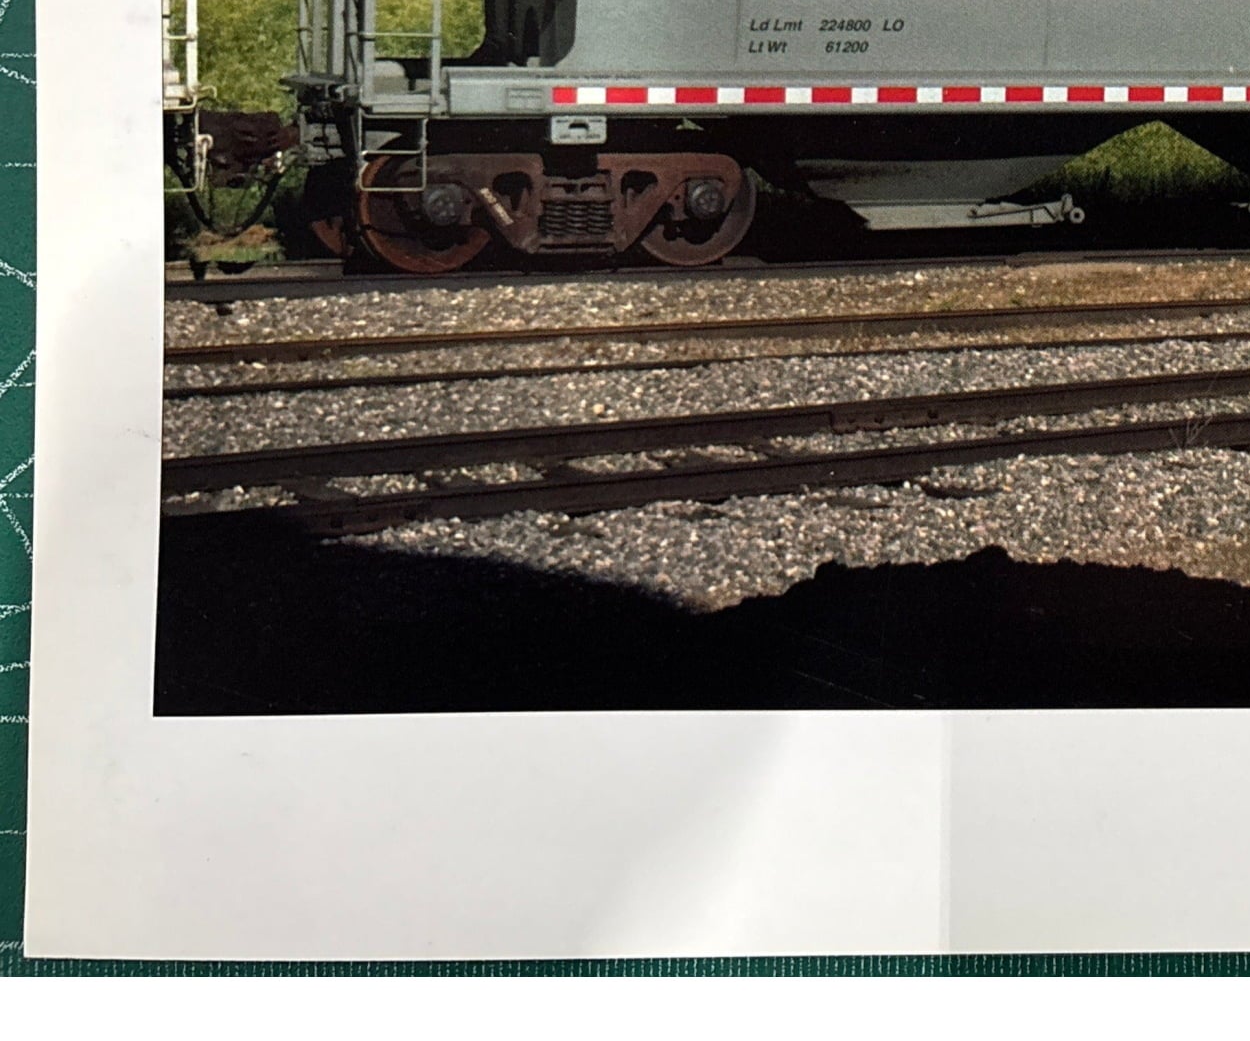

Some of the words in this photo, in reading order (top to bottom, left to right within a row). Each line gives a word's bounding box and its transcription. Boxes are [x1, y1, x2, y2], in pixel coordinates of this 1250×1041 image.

[750, 19, 769, 32] Ld
[773, 19, 803, 32] Lmt
[818, 19, 872, 32] 224800
[882, 20, 904, 32] LO
[748, 41, 764, 53] Lt
[767, 41, 787, 54] Wt
[825, 41, 869, 54] 61200
